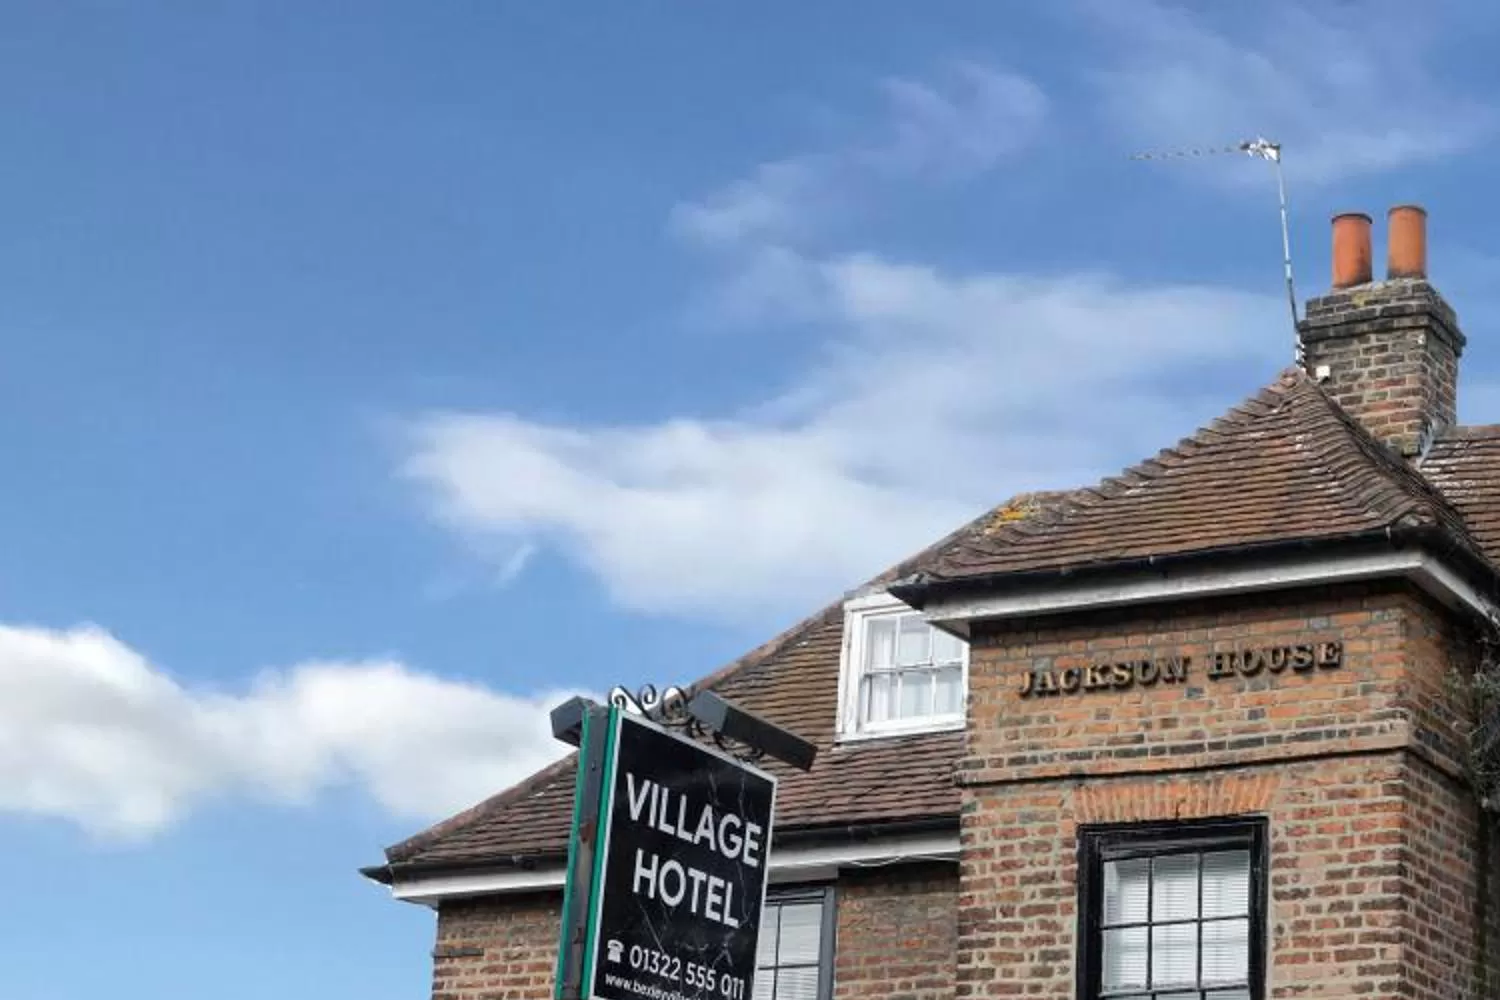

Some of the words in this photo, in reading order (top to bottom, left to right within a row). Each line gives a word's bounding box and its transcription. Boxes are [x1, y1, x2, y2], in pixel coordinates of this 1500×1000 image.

[1018, 655, 1190, 699] JACKSON
[1207, 640, 1344, 681] HOUSE
[625, 772, 763, 868] VILLAGE
[633, 848, 740, 929] HOTEL
[629, 945, 681, 980] 01322
[685, 961, 717, 991] 555
[721, 973, 745, 1000] 011
